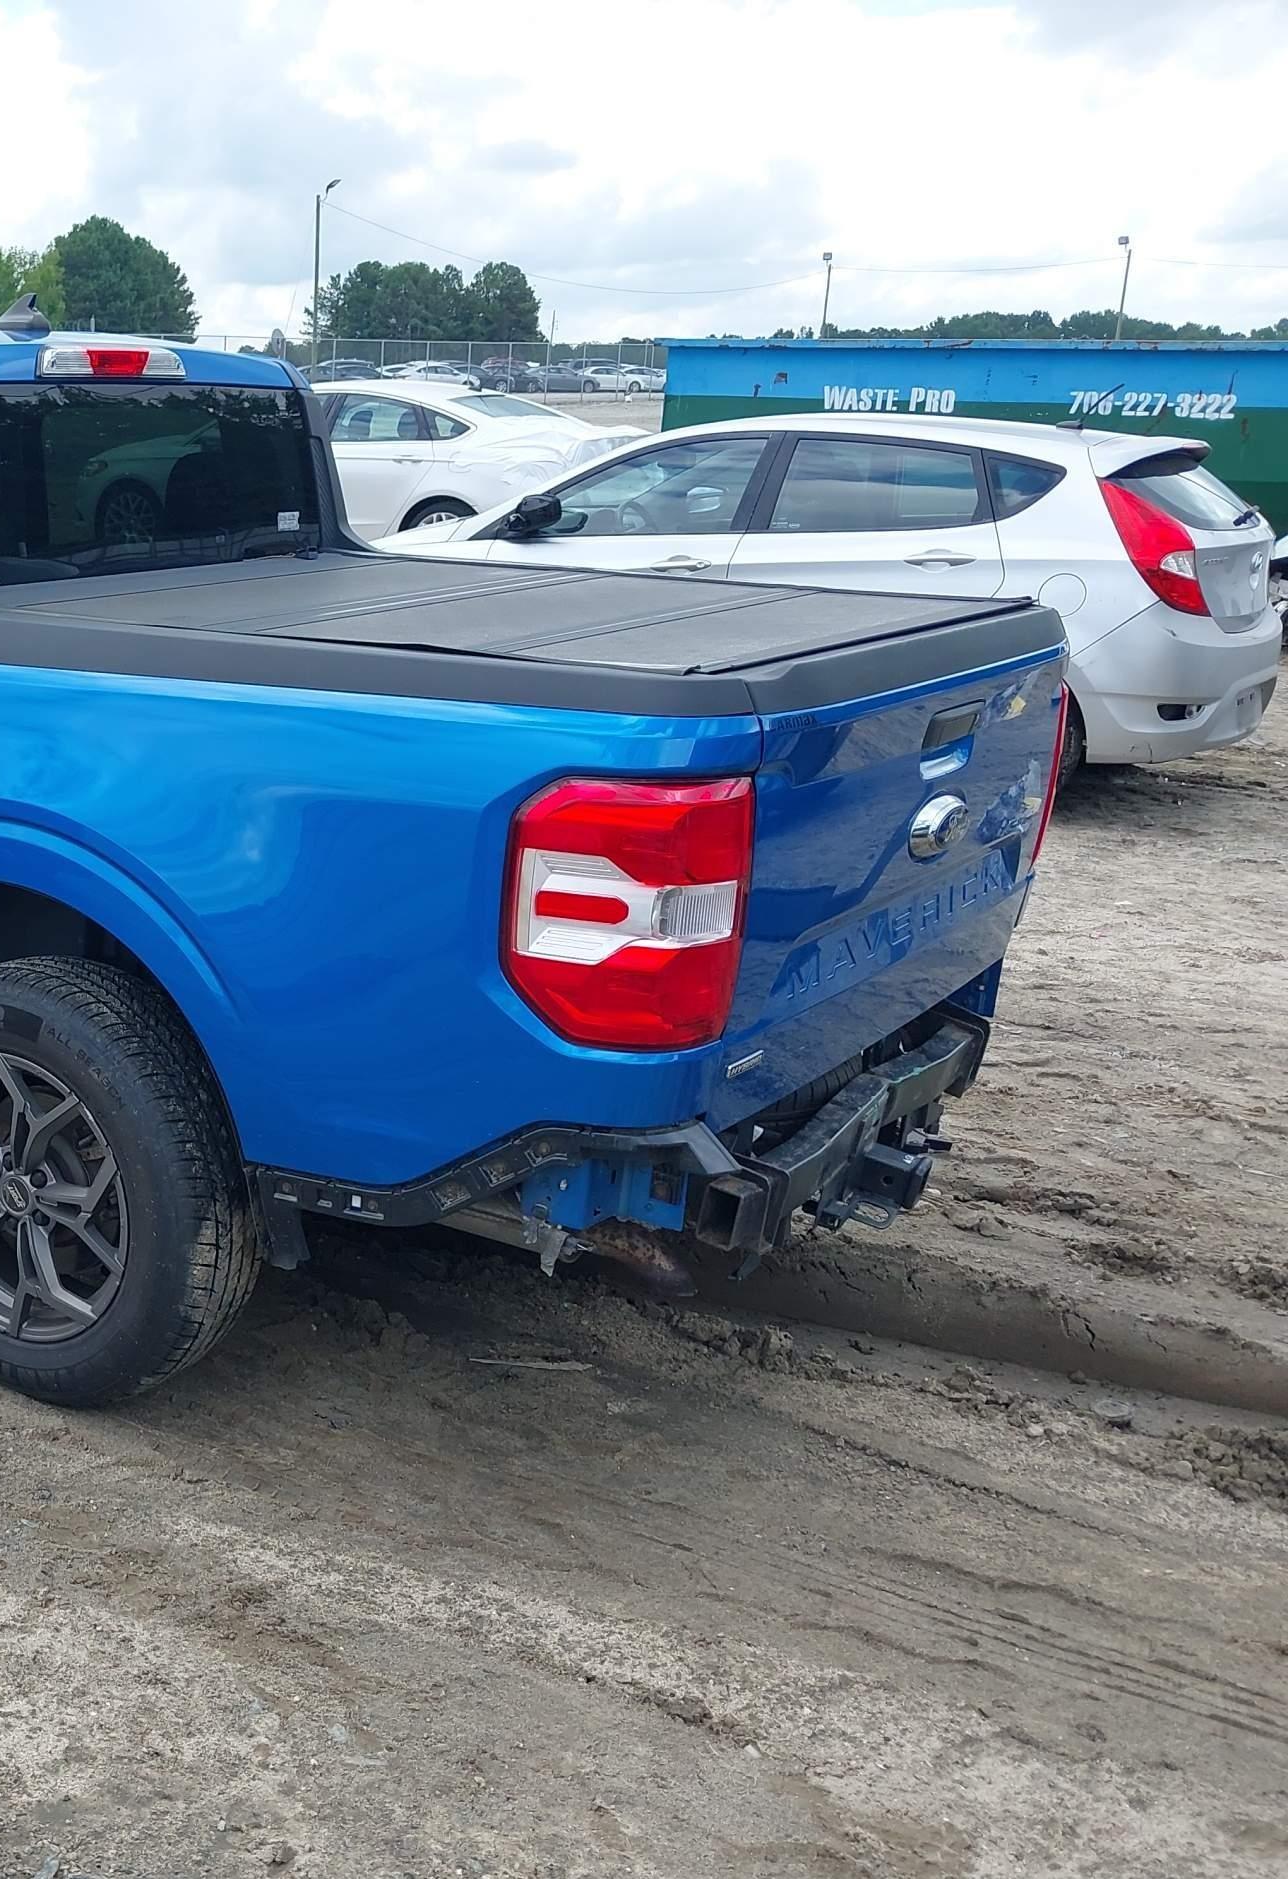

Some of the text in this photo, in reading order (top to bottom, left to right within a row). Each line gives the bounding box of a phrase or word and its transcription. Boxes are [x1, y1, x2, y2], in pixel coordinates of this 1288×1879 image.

[824, 385, 956, 413] WASTE PRO
[786, 849, 1014, 1000] MAVERICK
[46, 1026, 71, 1050] ALL
